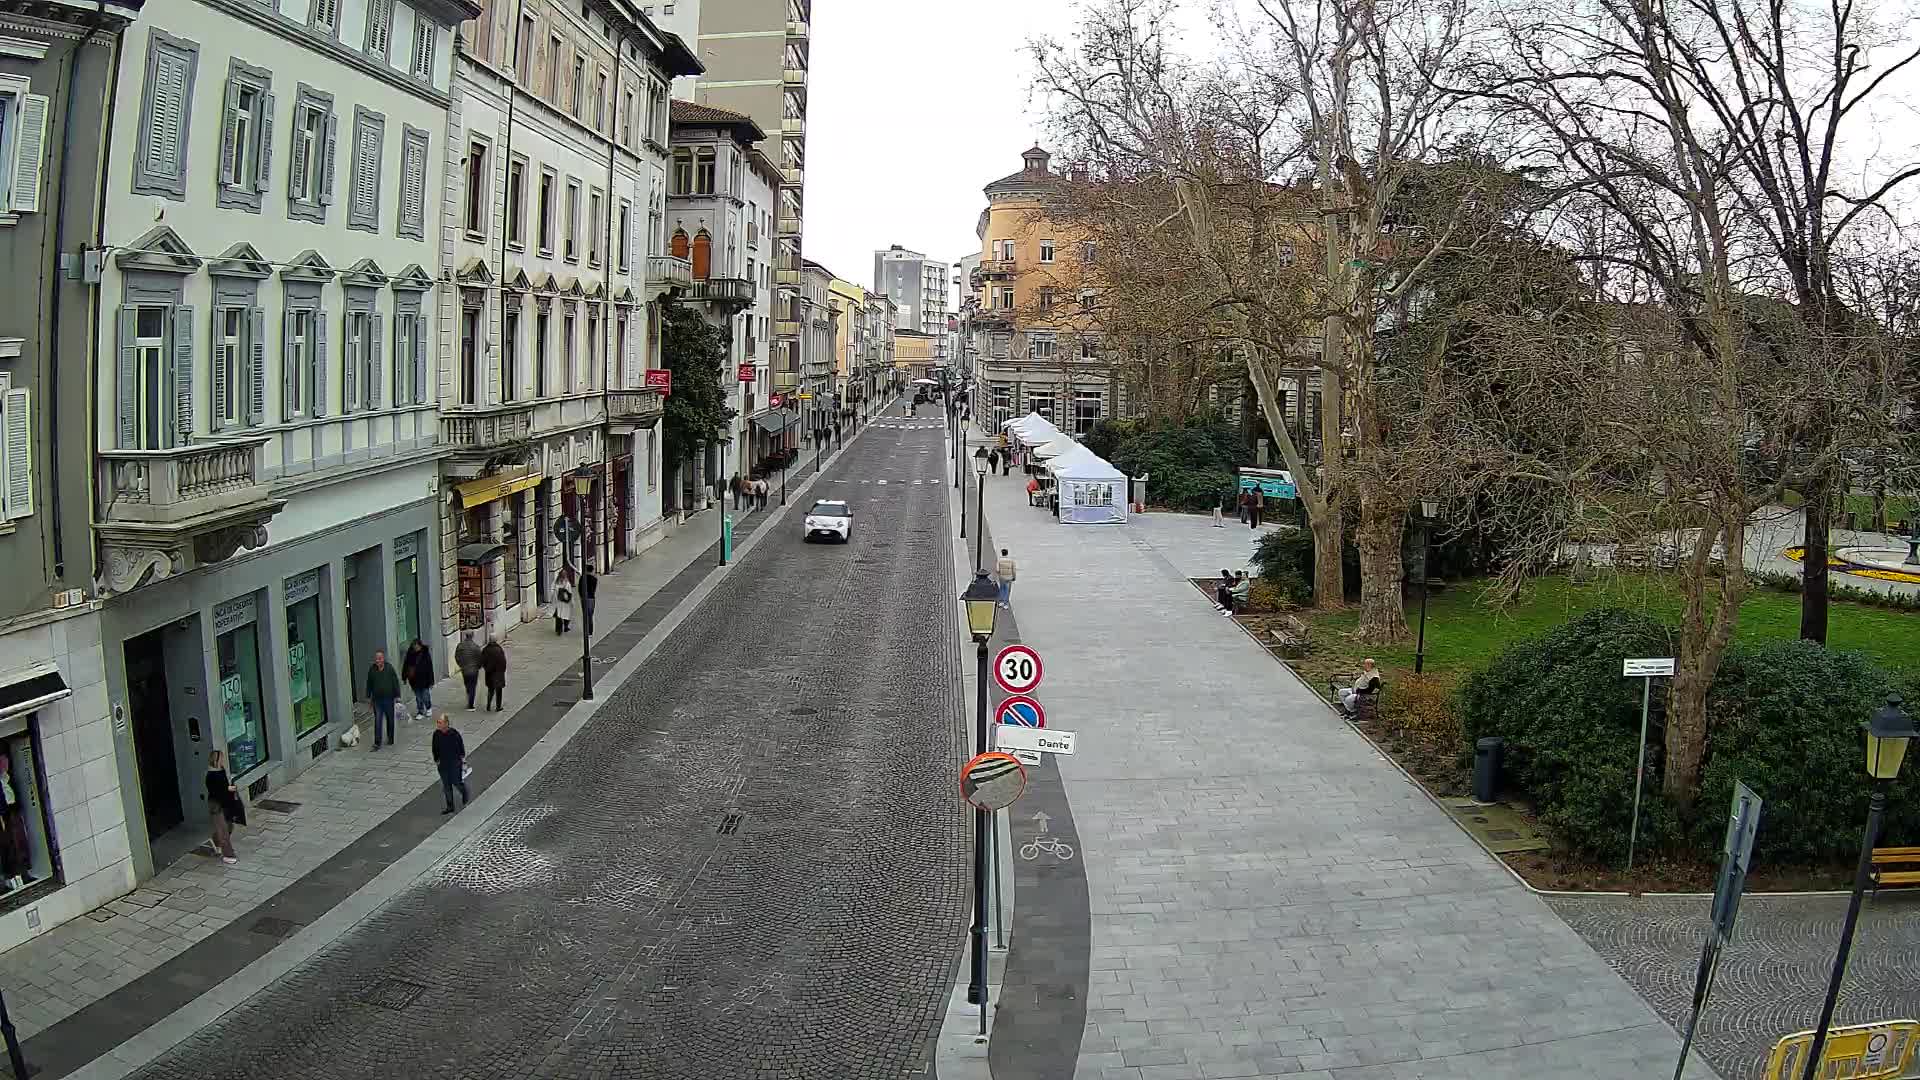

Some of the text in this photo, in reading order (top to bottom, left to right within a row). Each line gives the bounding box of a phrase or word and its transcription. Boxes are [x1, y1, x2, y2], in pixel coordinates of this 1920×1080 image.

[1005, 658, 1033, 680] 30
[222, 677, 241, 700] 130
[1038, 738, 1070, 750] Dante
